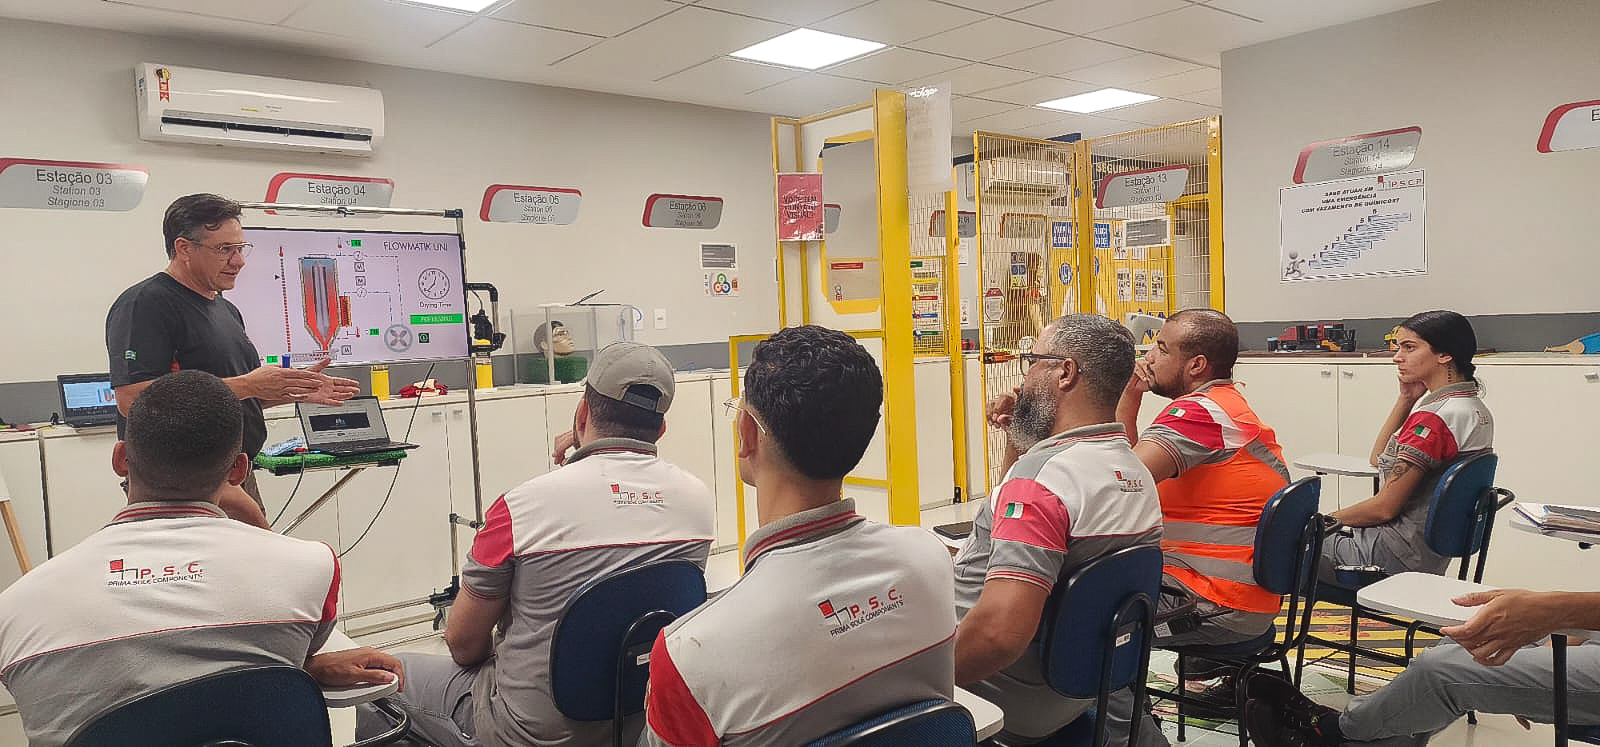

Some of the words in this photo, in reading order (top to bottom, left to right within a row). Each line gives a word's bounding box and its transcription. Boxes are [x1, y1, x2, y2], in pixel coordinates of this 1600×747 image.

[1333, 142, 1374, 157] Estação
[1376, 137, 1390, 151] 14
[36, 168, 92, 186] Estação
[96, 172, 113, 185] 03
[1124, 175, 1155, 188] Estação
[1157, 173, 1168, 183] 13
[52, 185, 87, 195] Station
[89, 186, 101, 196] 03
[307, 181, 350, 197] Estação
[353, 185, 366, 196] 04
[48, 196, 90, 208] Stagione
[93, 198, 105, 208] 03
[513, 192, 547, 206] Estação
[549, 194, 560, 205] 05
[383, 241, 431, 251] FLOWMATIK
[432, 242, 448, 252] UNI
[419, 301, 438, 309] Drying
[152, 573, 204, 584] COMPONENTS
[829, 624, 851, 638] PRIMA
[850, 616, 866, 629] SOLE
[865, 599, 904, 622] COMPONENTS
